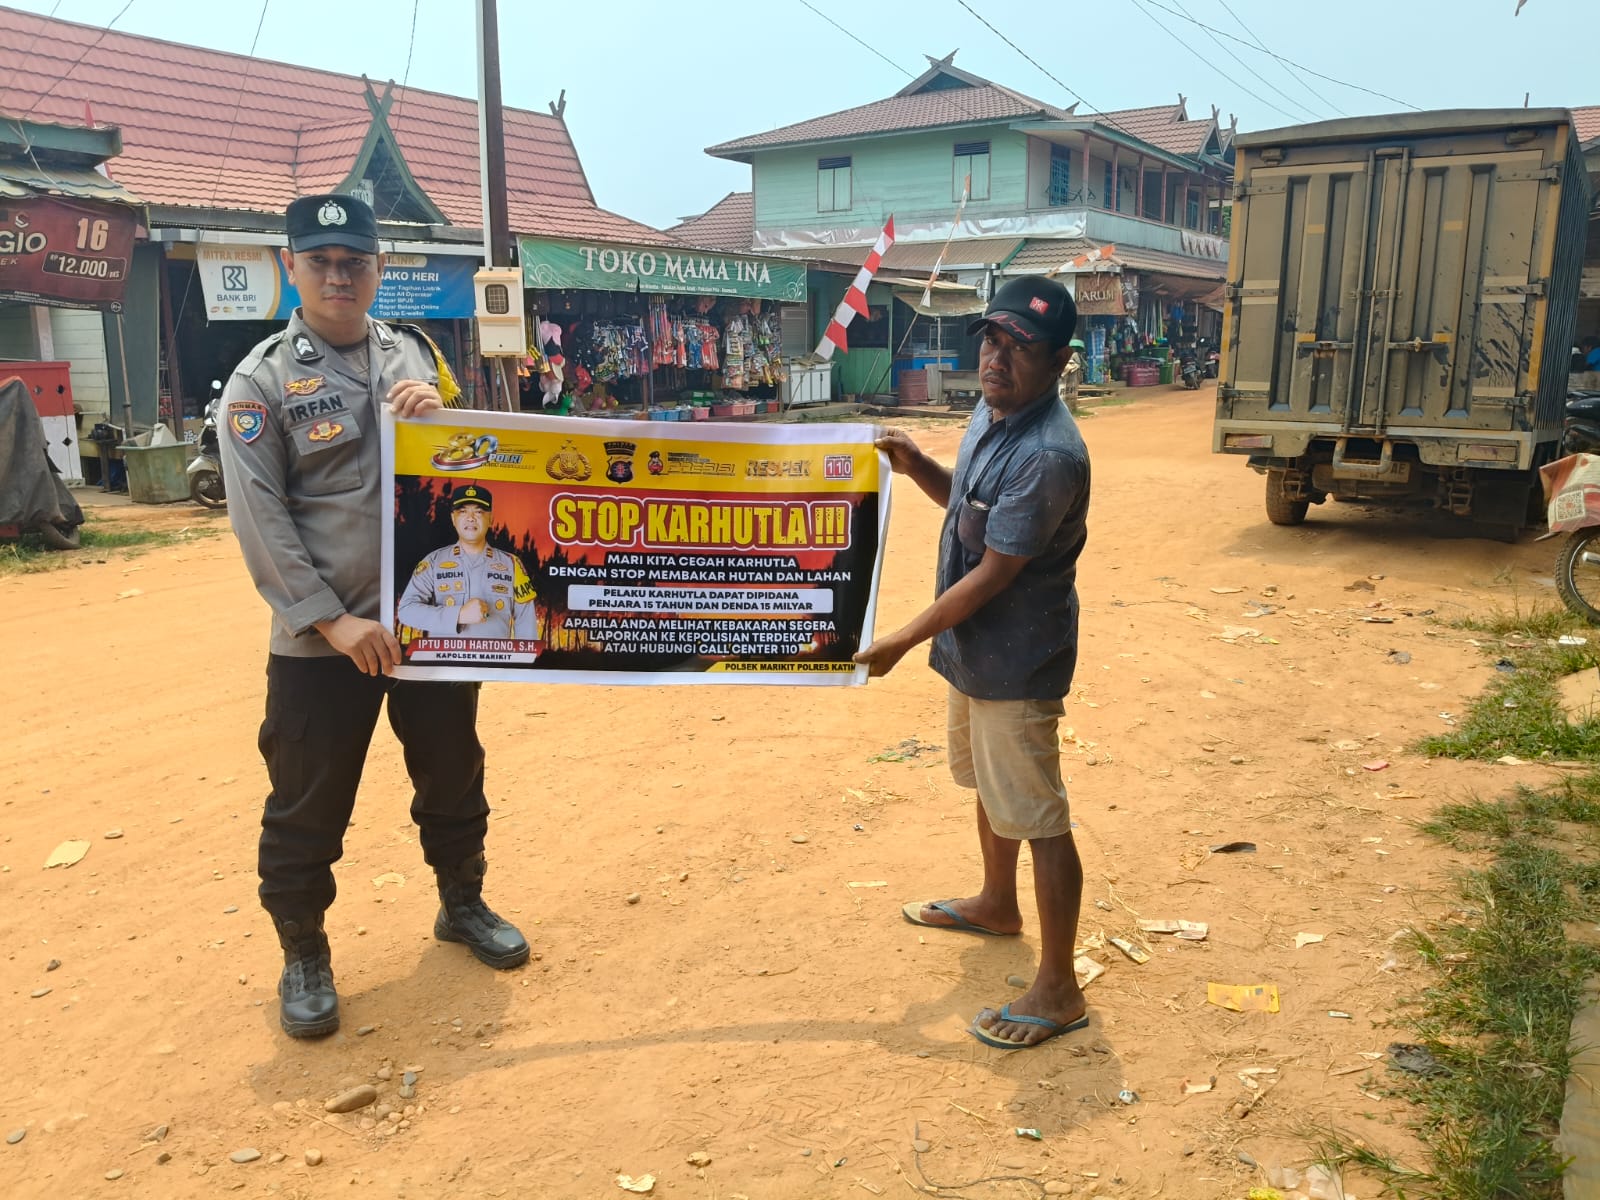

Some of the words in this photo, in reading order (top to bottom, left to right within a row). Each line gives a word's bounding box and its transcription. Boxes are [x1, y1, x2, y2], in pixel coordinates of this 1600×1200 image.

[77, 217, 108, 251] 16
[579, 247, 657, 276] TOKO
[663, 252, 730, 283] MAMA
[735, 259, 772, 285] INA
[412, 272, 439, 282] HERI
[217, 294, 240, 302] BANK
[243, 294, 257, 302] BRI
[288, 394, 343, 422] IRFAN
[488, 453, 524, 463] POLRI
[827, 461, 851, 474] 110
[556, 498, 640, 541] STOP
[648, 503, 808, 545] KARHUTLA
[814, 506, 846, 544] !!!
[607, 554, 643, 565] MARI
[647, 555, 676, 566] KITA
[679, 556, 724, 567] CEGAH
[728, 557, 796, 568] KARHUTLA
[487, 572, 512, 581] POLRI
[549, 566, 607, 578] DENGAN
[610, 568, 645, 579] STOP
[648, 570, 725, 581] MEMBAKAR
[732, 571, 773, 582] HUTAN
[776, 571, 803, 582] DAN
[807, 571, 851, 582] LAHAN
[603, 588, 646, 598] PELAKU
[648, 590, 705, 600] KARHUTLA
[709, 591, 745, 600] DAPAT
[746, 591, 799, 600] DIPIDANA
[589, 599, 641, 608] PENJARA
[643, 600, 653, 609] 15
[656, 601, 692, 610] TAHUN
[696, 602, 719, 610] DAN
[722, 602, 758, 610] DENDA
[761, 602, 770, 610] 15
[773, 602, 813, 610] MILYAR
[564, 617, 618, 629] APABILA
[620, 619, 656, 630] ANDA
[659, 619, 711, 631] MELIHAT
[714, 620, 787, 631] KEBAKARAN
[789, 620, 836, 631] SEGERA
[590, 630, 657, 641] LAPORKAN
[661, 632, 676, 641] KE
[679, 632, 749, 642] KEPOLISIAN
[752, 632, 813, 642] TERDEKAT
[418, 639, 440, 649] IPTU
[443, 640, 466, 649] BUDI
[469, 640, 515, 652] HARTONO,
[518, 641, 537, 652] S.H.
[604, 642, 636, 653] ATAU
[640, 643, 696, 654] HUBUNGI
[700, 644, 730, 654] CALL
[732, 644, 778, 654] CENTER
[781, 644, 798, 654] 110
[725, 663, 757, 671] POLSEK
[760, 663, 795, 671] MARIKIT
[798, 663, 829, 671] POLRES
